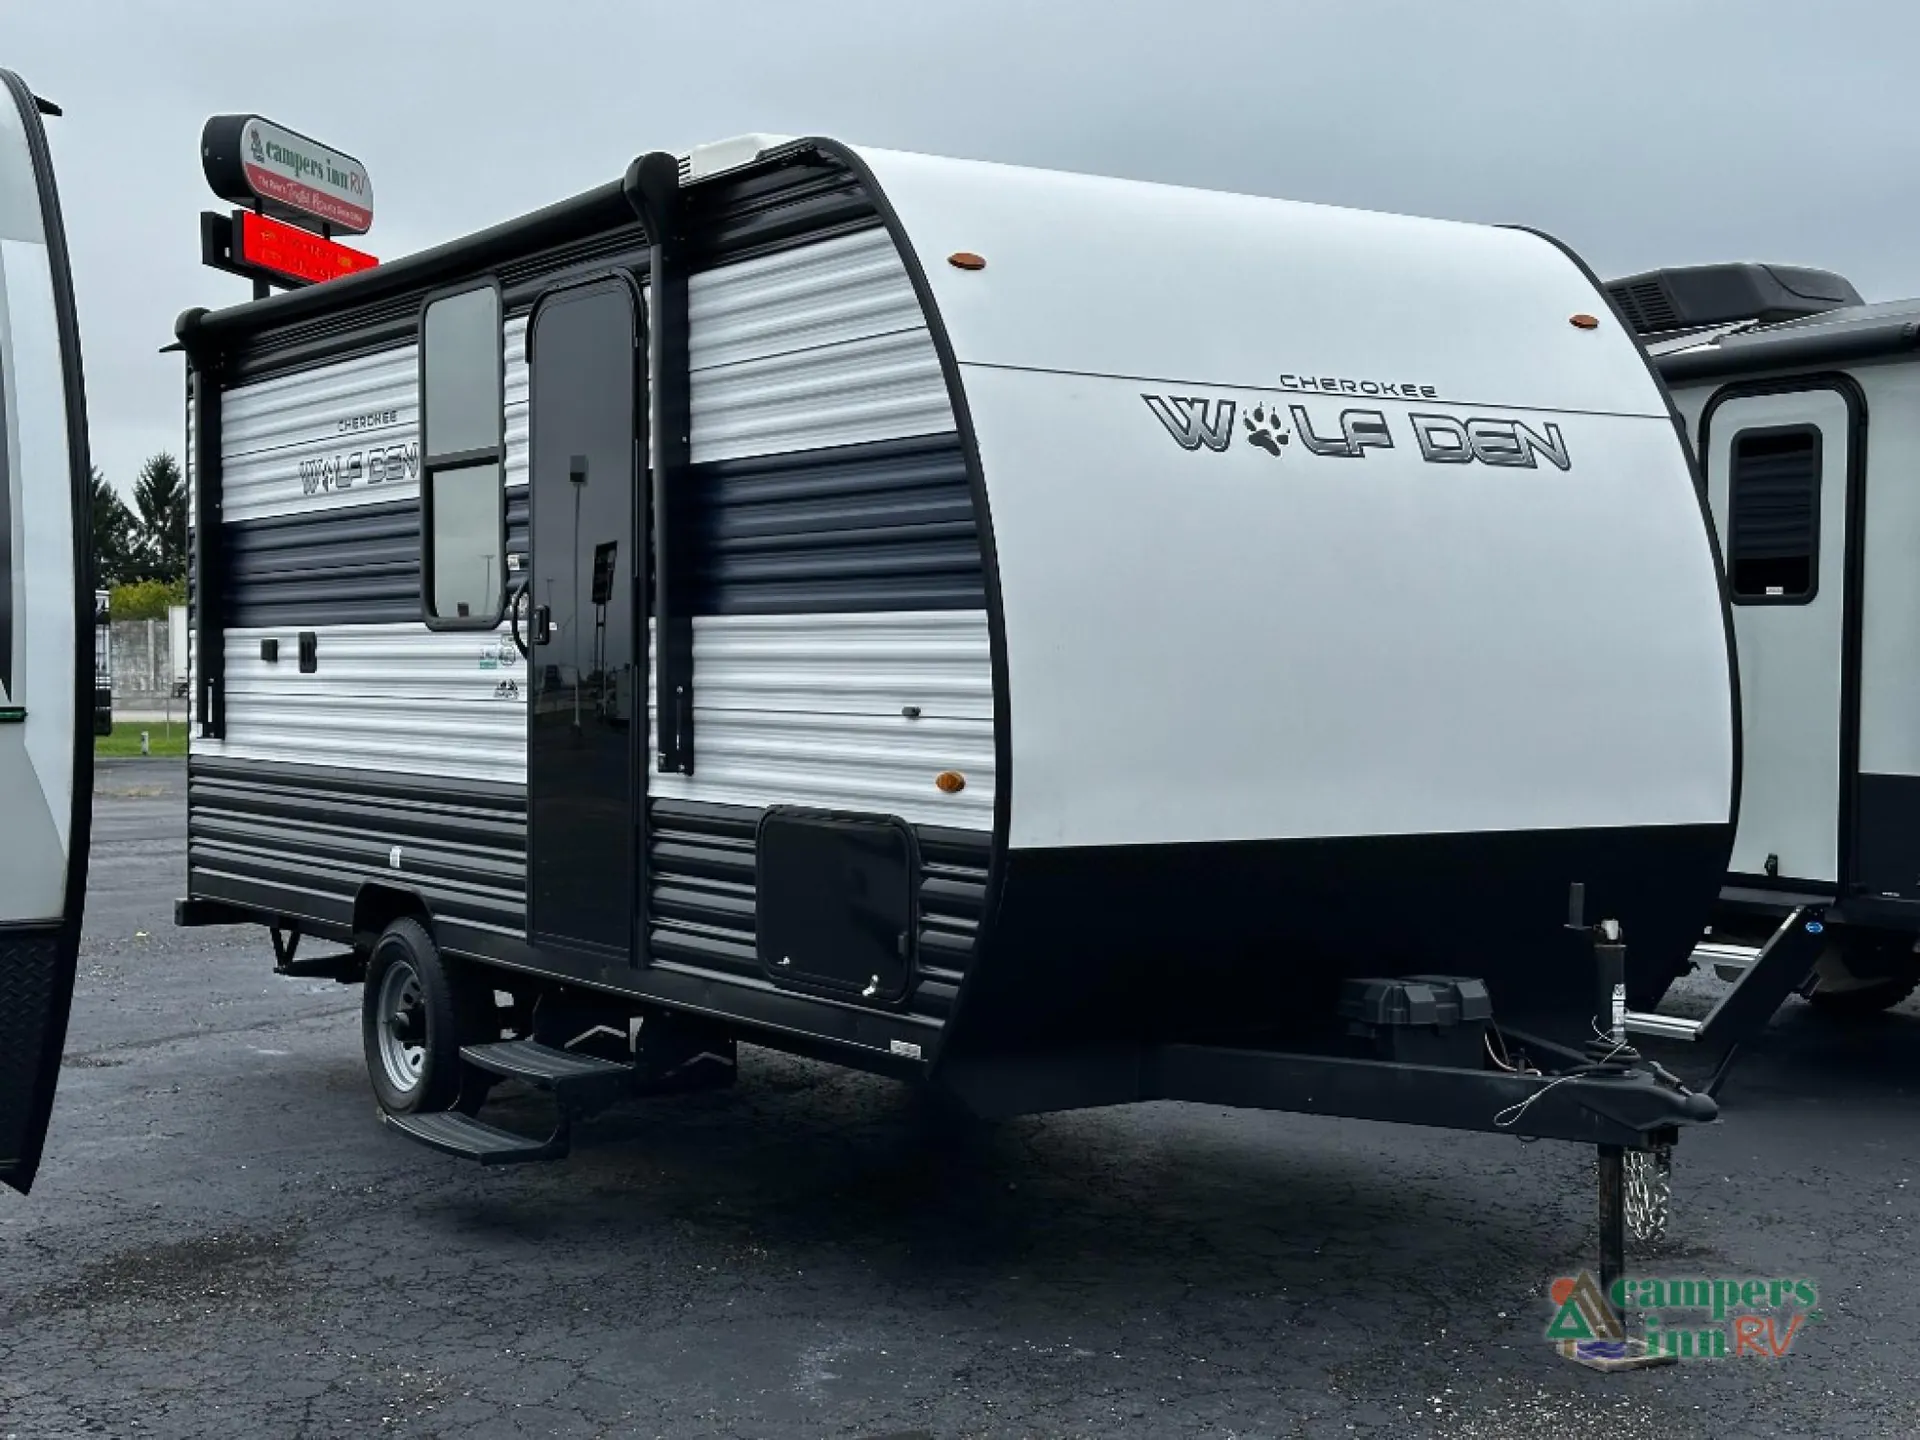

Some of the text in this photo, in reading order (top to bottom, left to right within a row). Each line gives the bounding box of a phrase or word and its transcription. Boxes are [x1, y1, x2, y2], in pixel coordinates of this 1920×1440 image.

[266, 141, 366, 196] campers inn RV
[1280, 374, 1438, 398] CHEROKEE
[338, 410, 398, 431] CHEROKEE
[1408, 412, 1571, 471] DEN
[368, 442, 419, 485] DEN
